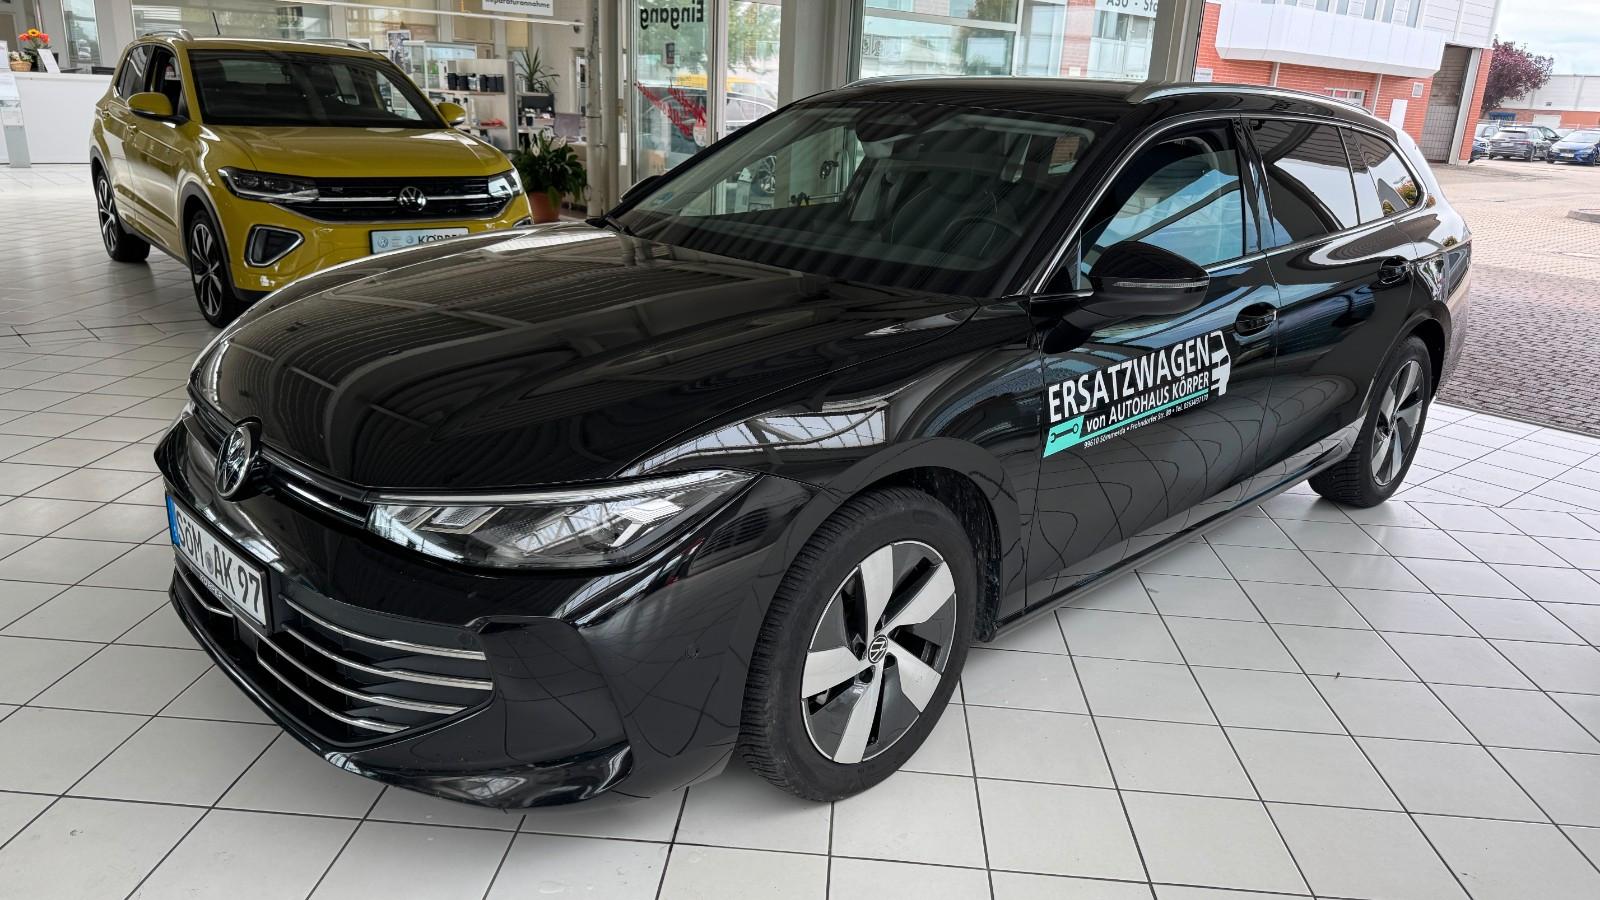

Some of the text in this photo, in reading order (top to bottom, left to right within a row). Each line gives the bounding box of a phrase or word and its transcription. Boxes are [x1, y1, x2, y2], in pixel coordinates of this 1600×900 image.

[1048, 334, 1210, 423] ERSATZWAGEN
[1086, 371, 1210, 433] von AUTOHAUS KÖRPER
[176, 509, 260, 614] SÖM AK 97
